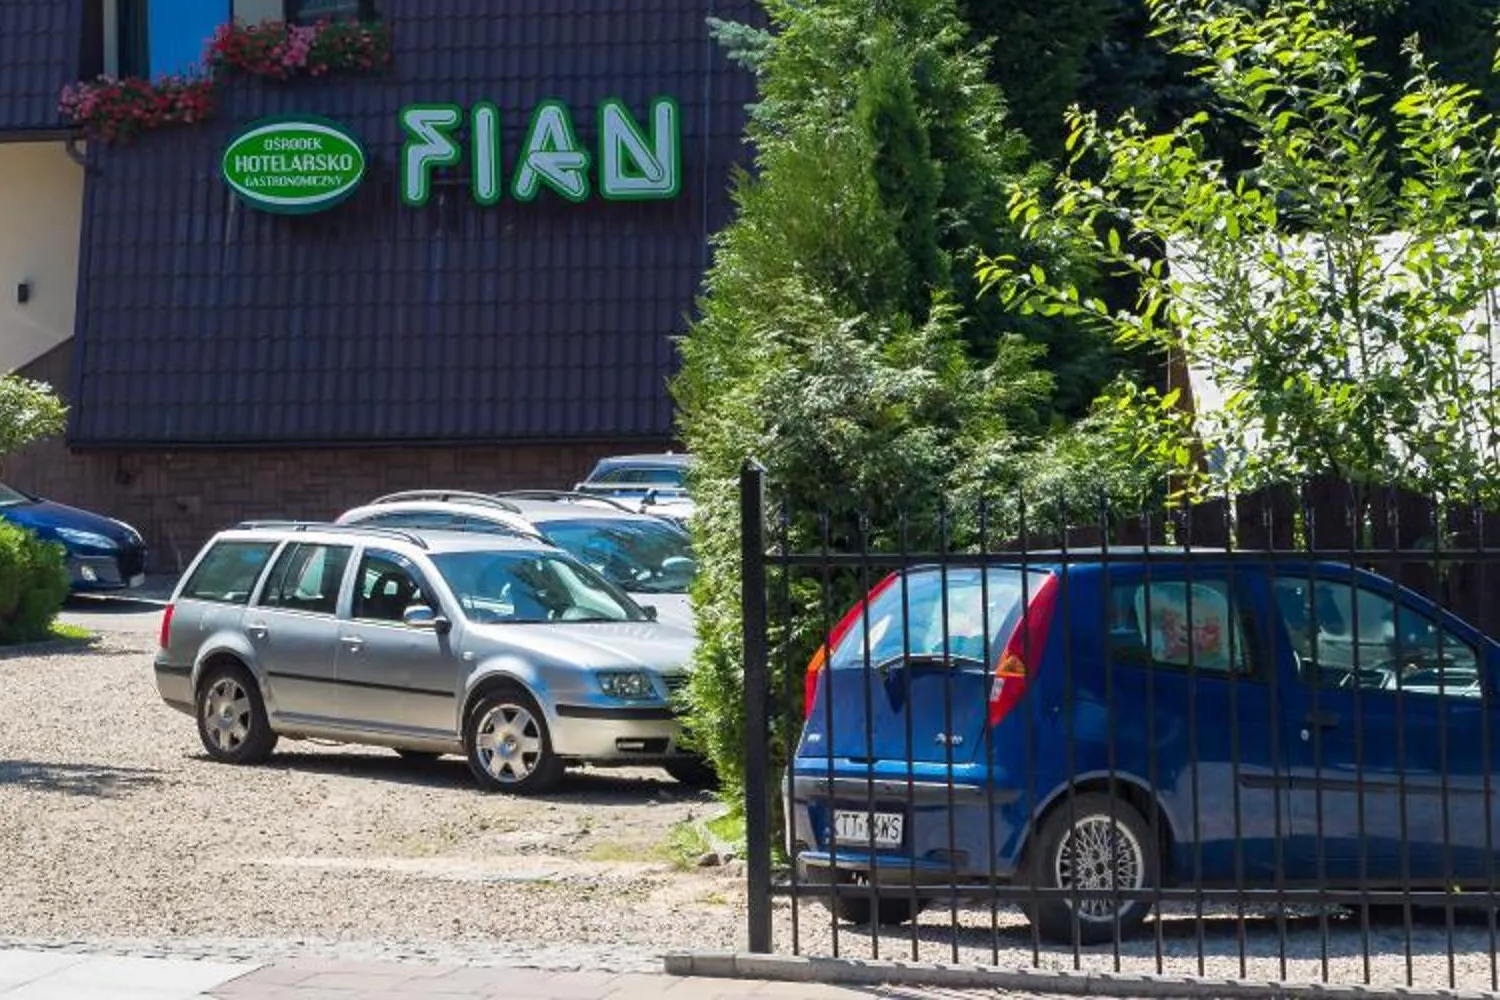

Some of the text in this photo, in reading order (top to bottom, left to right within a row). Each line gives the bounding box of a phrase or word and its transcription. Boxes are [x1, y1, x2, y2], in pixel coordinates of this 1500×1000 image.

[263, 136, 323, 151] OŚRODEK
[397, 97, 680, 206] FIAN
[234, 154, 353, 173] HOTELARSKO
